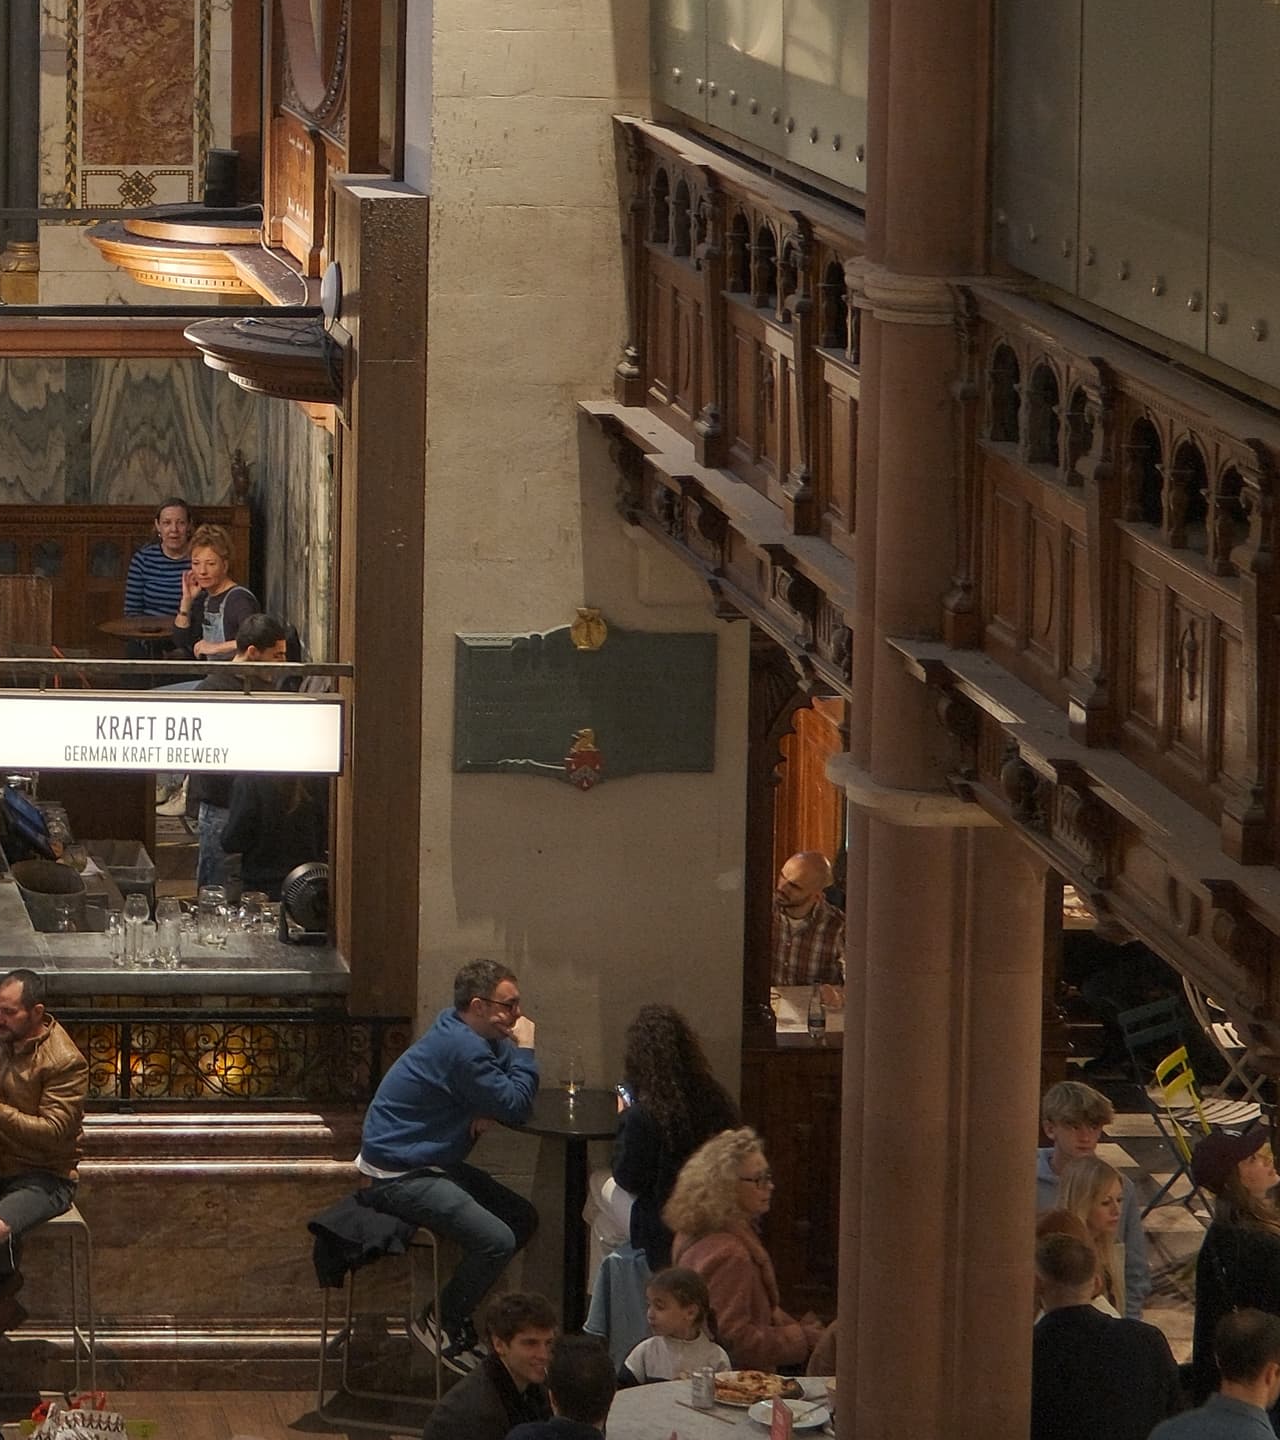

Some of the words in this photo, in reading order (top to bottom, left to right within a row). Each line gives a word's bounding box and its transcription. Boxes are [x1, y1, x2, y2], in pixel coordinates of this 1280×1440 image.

[95, 715, 157, 741] KRAFT
[165, 716, 203, 741] BAR
[64, 745, 118, 763] GERMAN
[122, 746, 161, 764] KRAFT
[166, 747, 229, 765] BREWERY
